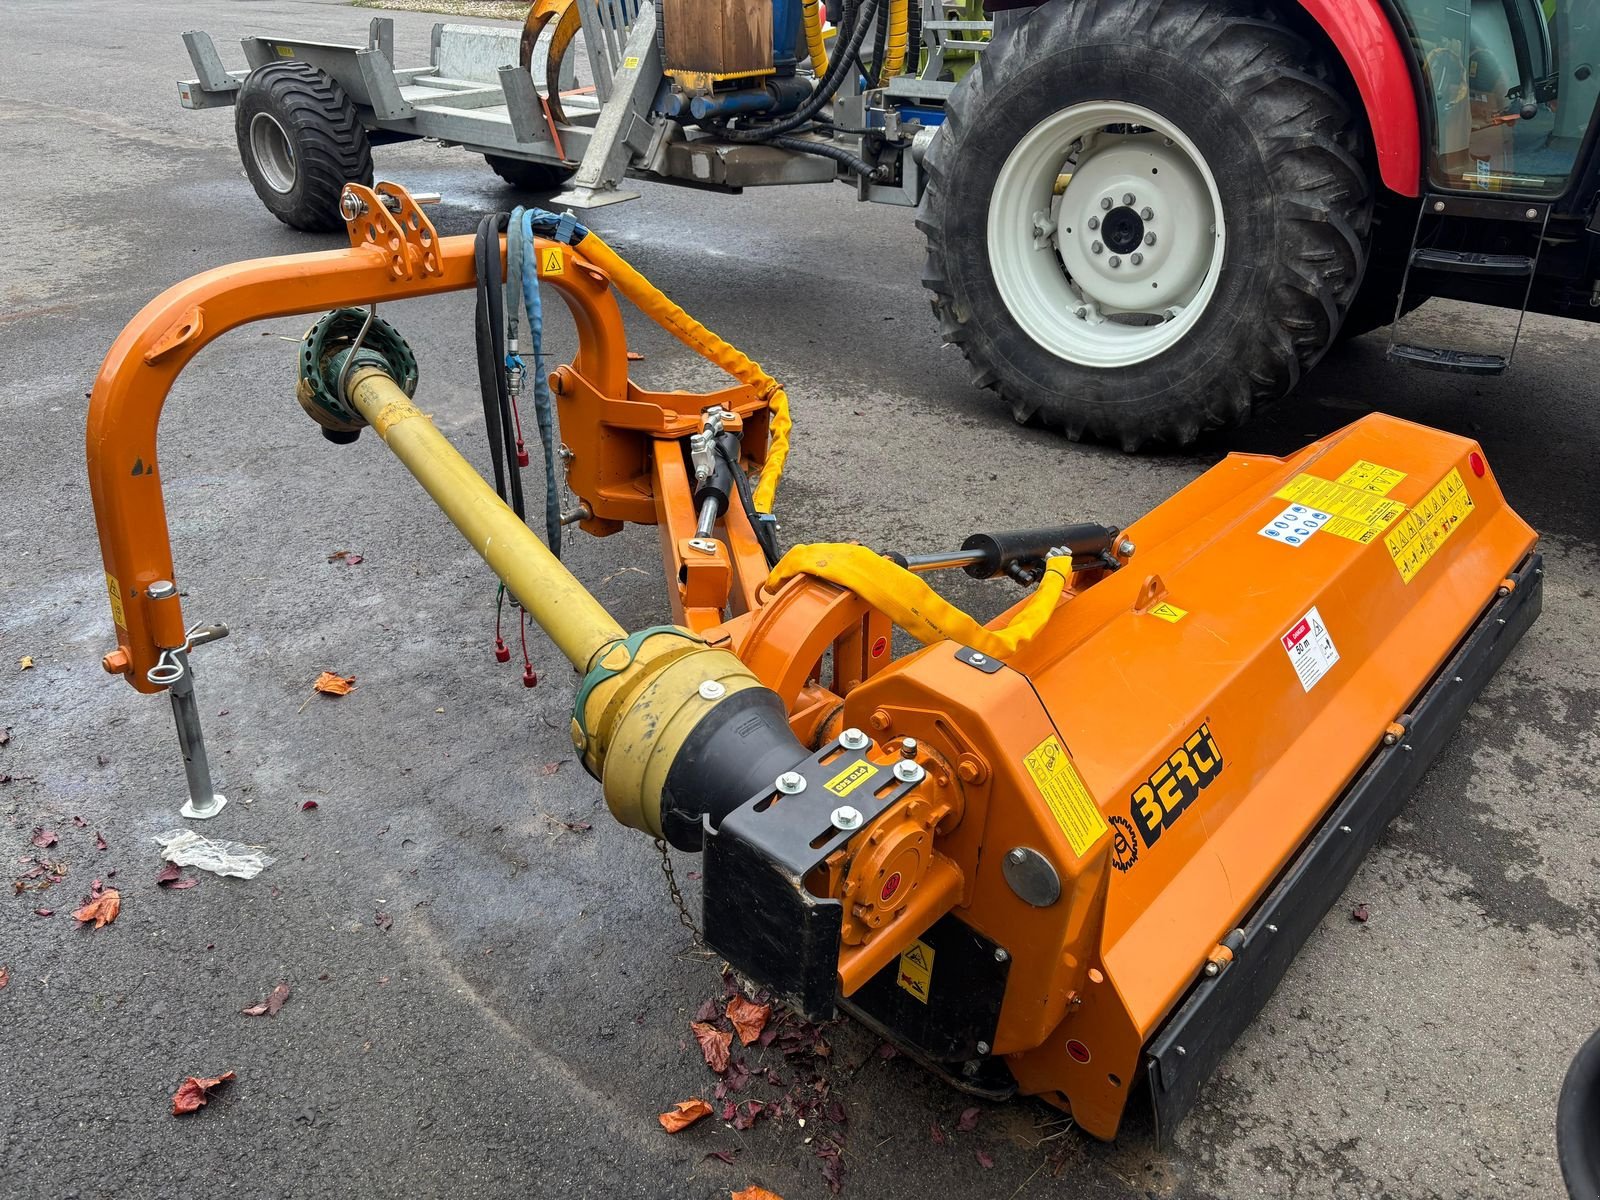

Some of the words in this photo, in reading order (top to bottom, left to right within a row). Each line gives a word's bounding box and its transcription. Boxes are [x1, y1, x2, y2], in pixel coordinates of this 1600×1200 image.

[1295, 643, 1305, 655] 50
[849, 766, 867, 780] PTO
[835, 778, 852, 791] 540
[1131, 722, 1223, 849] BERTI
